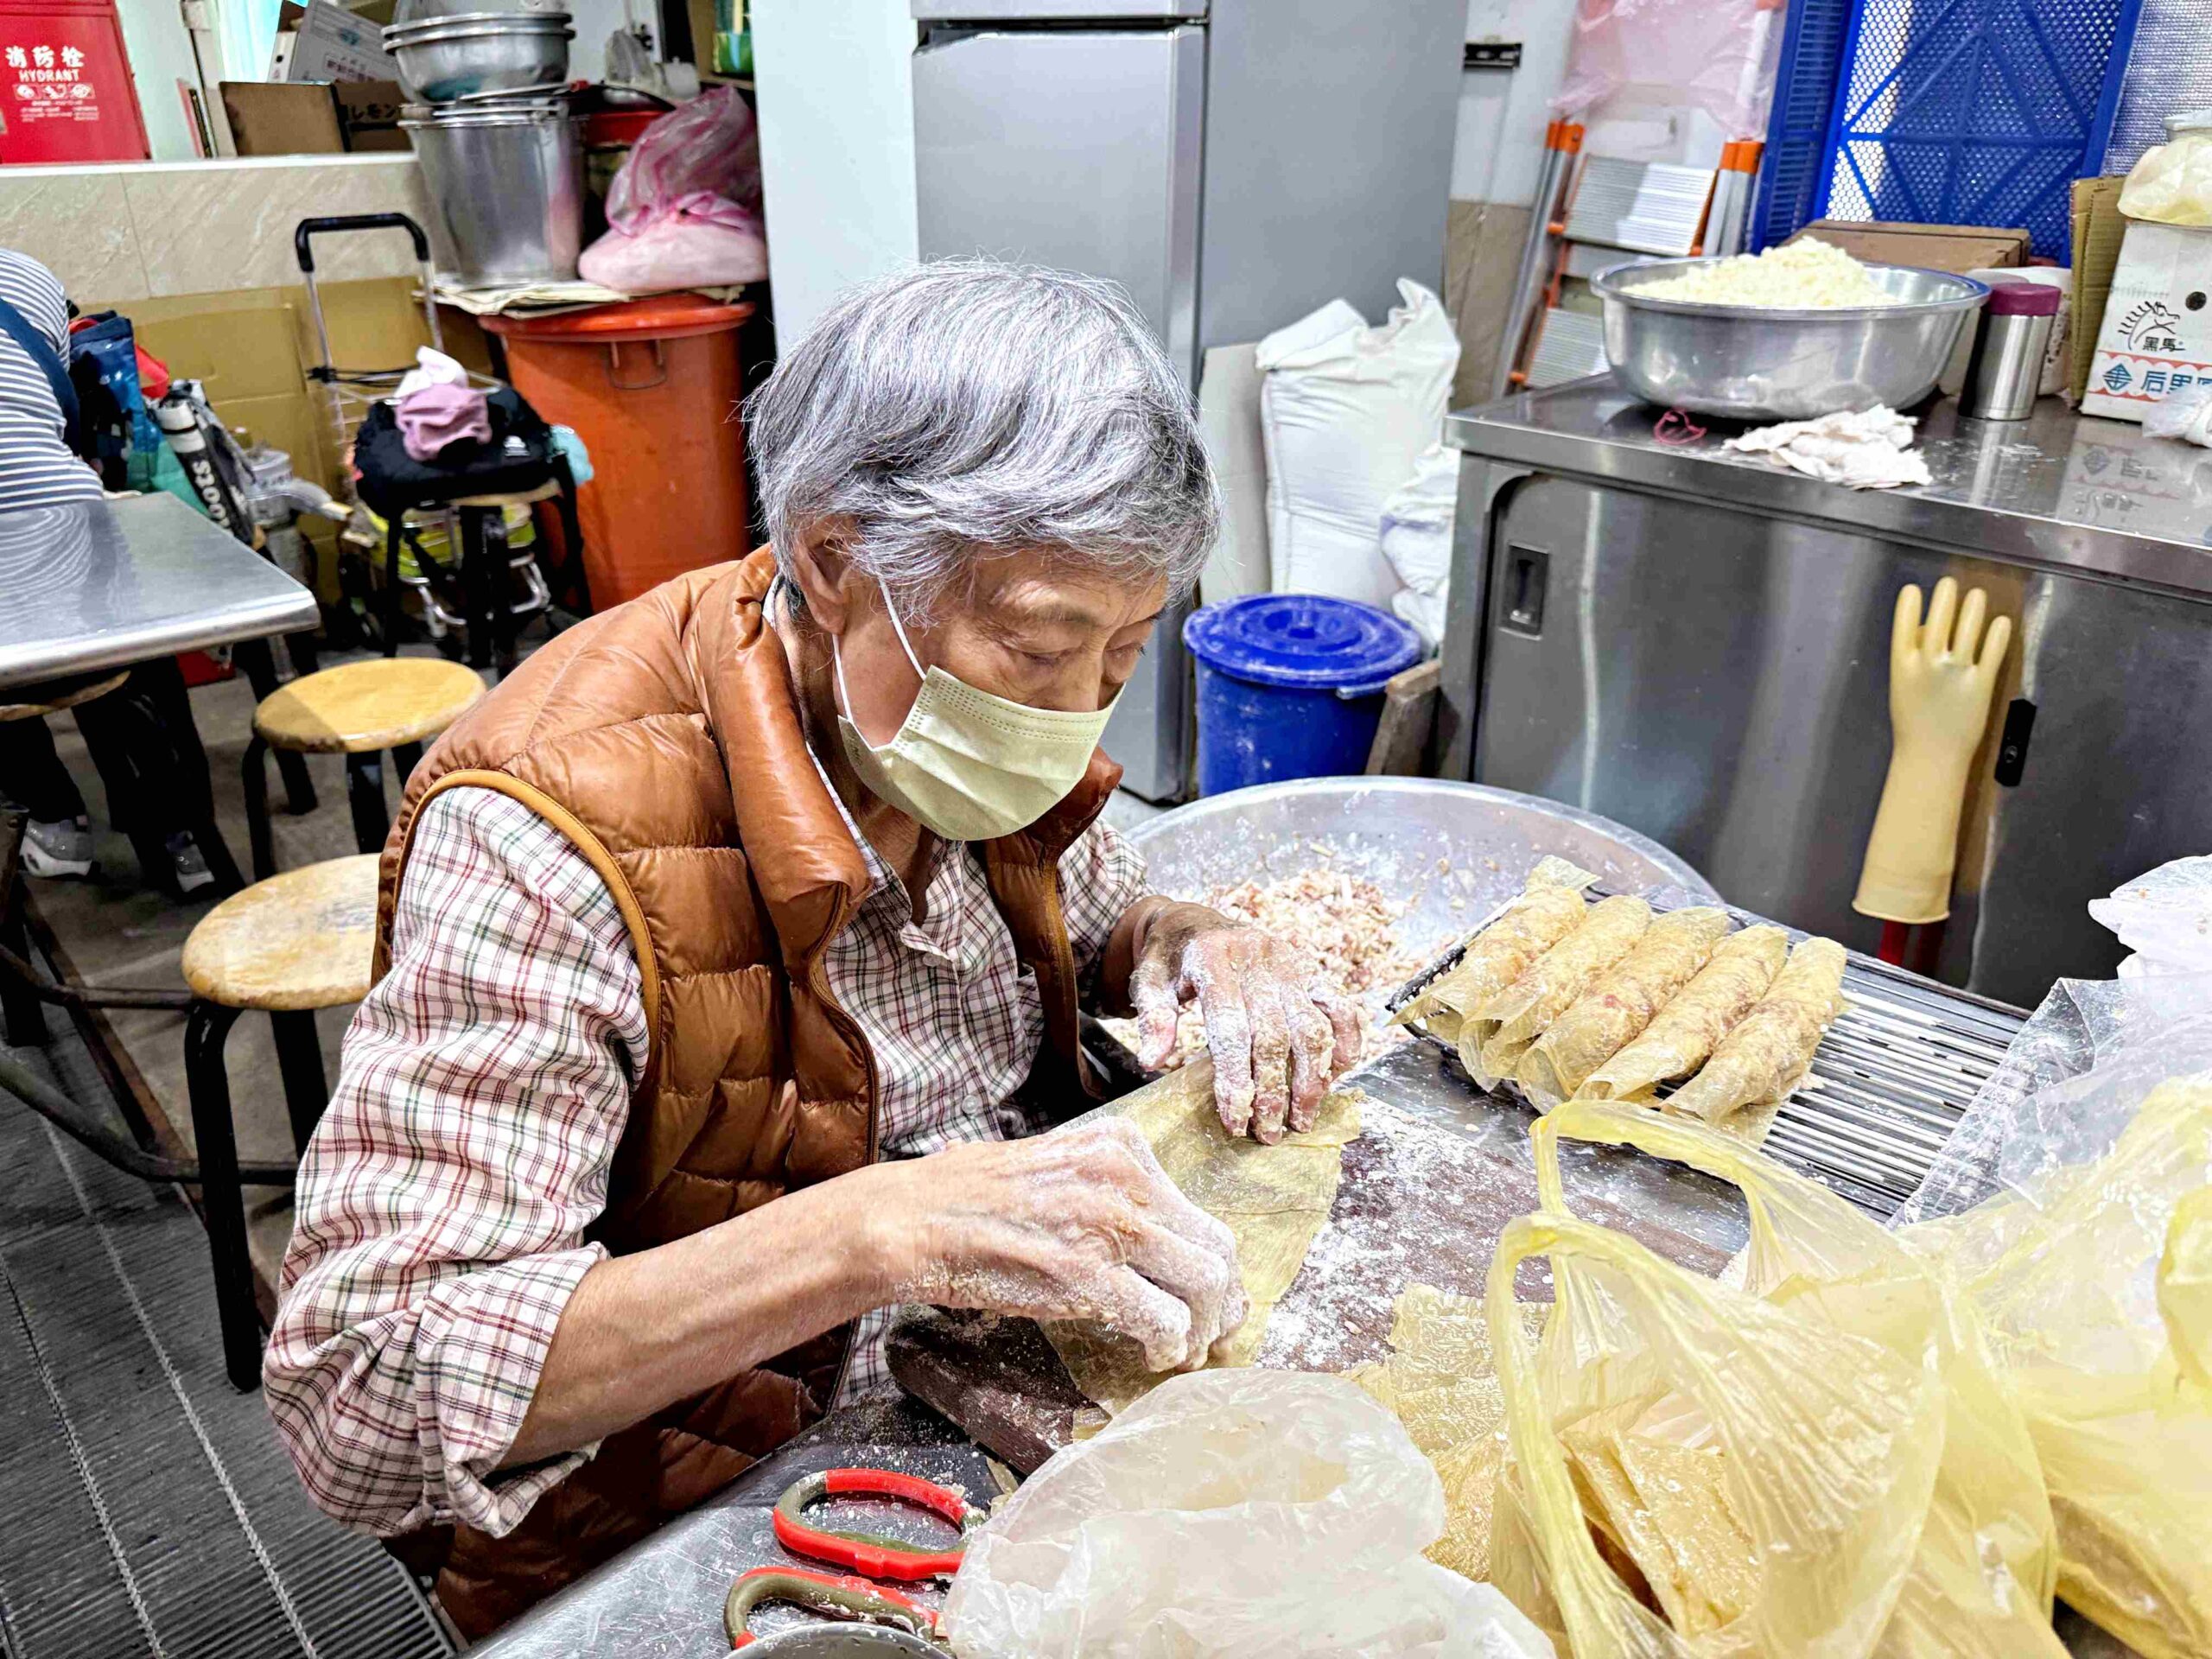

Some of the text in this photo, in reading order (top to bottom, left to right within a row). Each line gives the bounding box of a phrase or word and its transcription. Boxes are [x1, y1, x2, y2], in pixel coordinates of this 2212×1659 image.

[5, 45, 85, 68] 消防栓
[18, 69, 80, 83] HYDRANT
[2142, 335, 2185, 352] 黑馬
[2140, 370, 2212, 394] 后里
